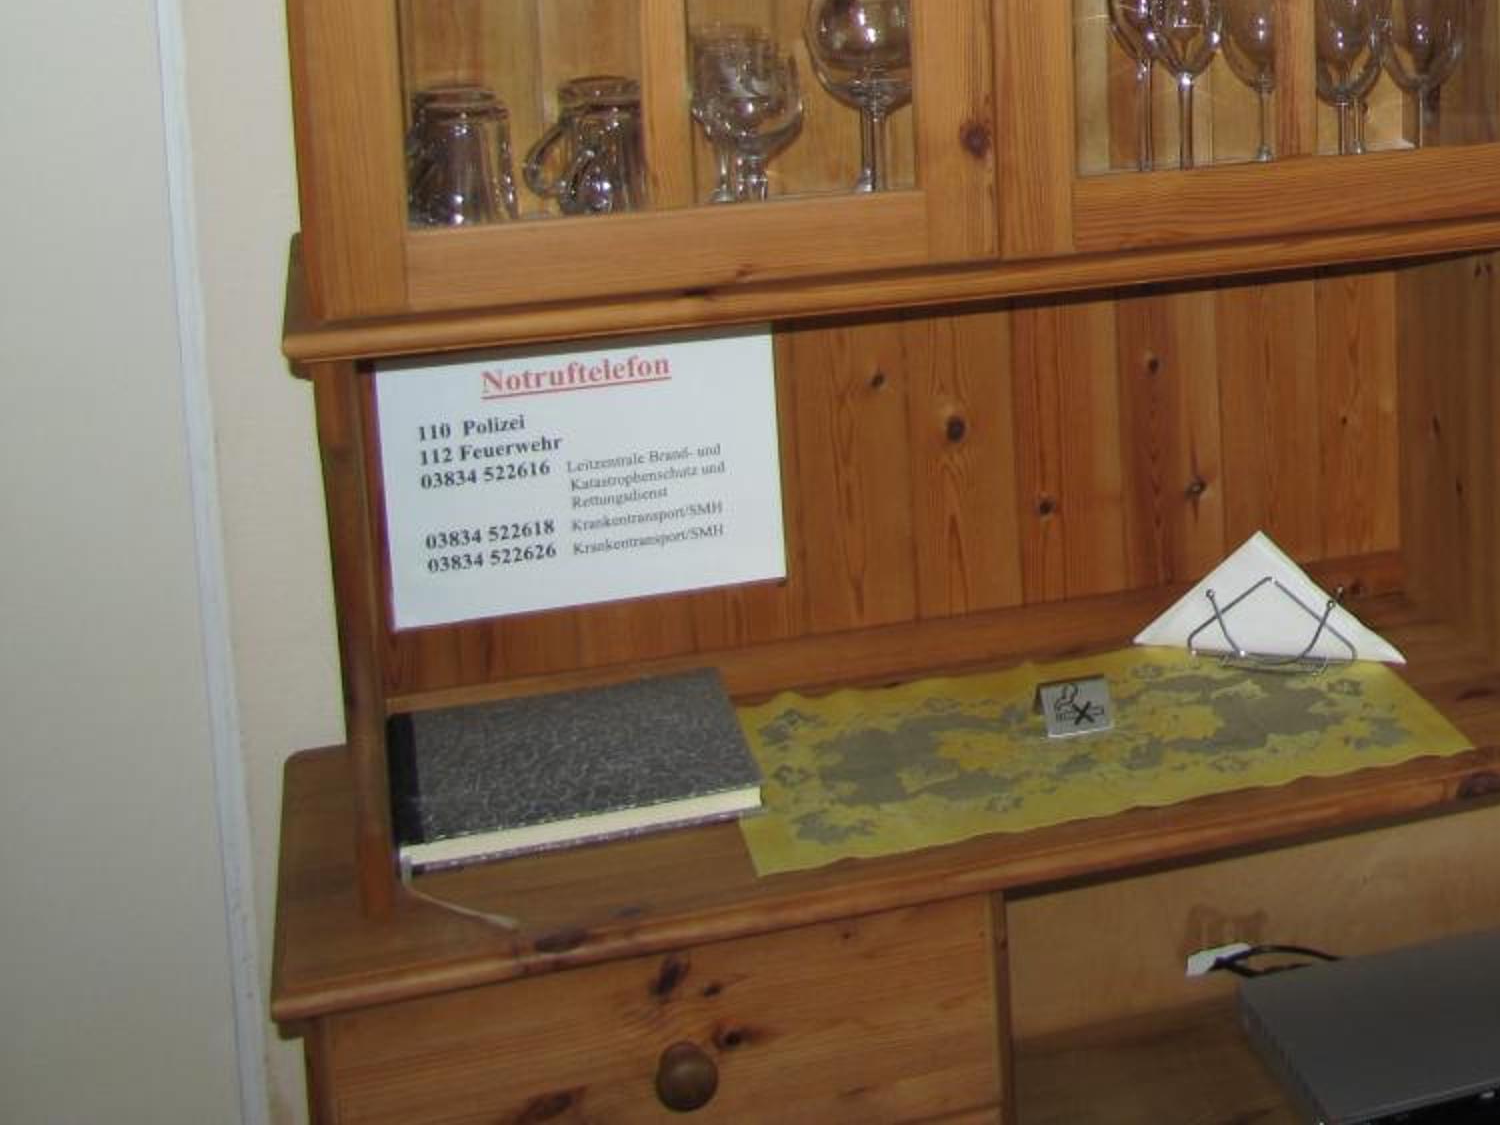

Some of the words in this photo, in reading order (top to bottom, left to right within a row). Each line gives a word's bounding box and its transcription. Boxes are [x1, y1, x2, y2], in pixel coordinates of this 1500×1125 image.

[480, 355, 672, 397] Notruftelefon
[419, 423, 451, 441] 110
[463, 414, 526, 437] Polizei
[420, 448, 453, 466] 112
[460, 436, 562, 461] Feuerwehr
[567, 453, 646, 474] Leitzentrale
[649, 446, 693, 463] Brand-
[697, 443, 721, 457] und
[421, 469, 477, 489] 03834
[484, 461, 551, 482] 522616
[571, 465, 697, 491] Katastrophenschutz
[701, 461, 725, 475] und
[572, 487, 668, 509] Rettungsdienst
[425, 529, 482, 550] 03834
[488, 518, 555, 542] 522618
[427, 552, 484, 573] 03834
[490, 543, 557, 565] 522626
